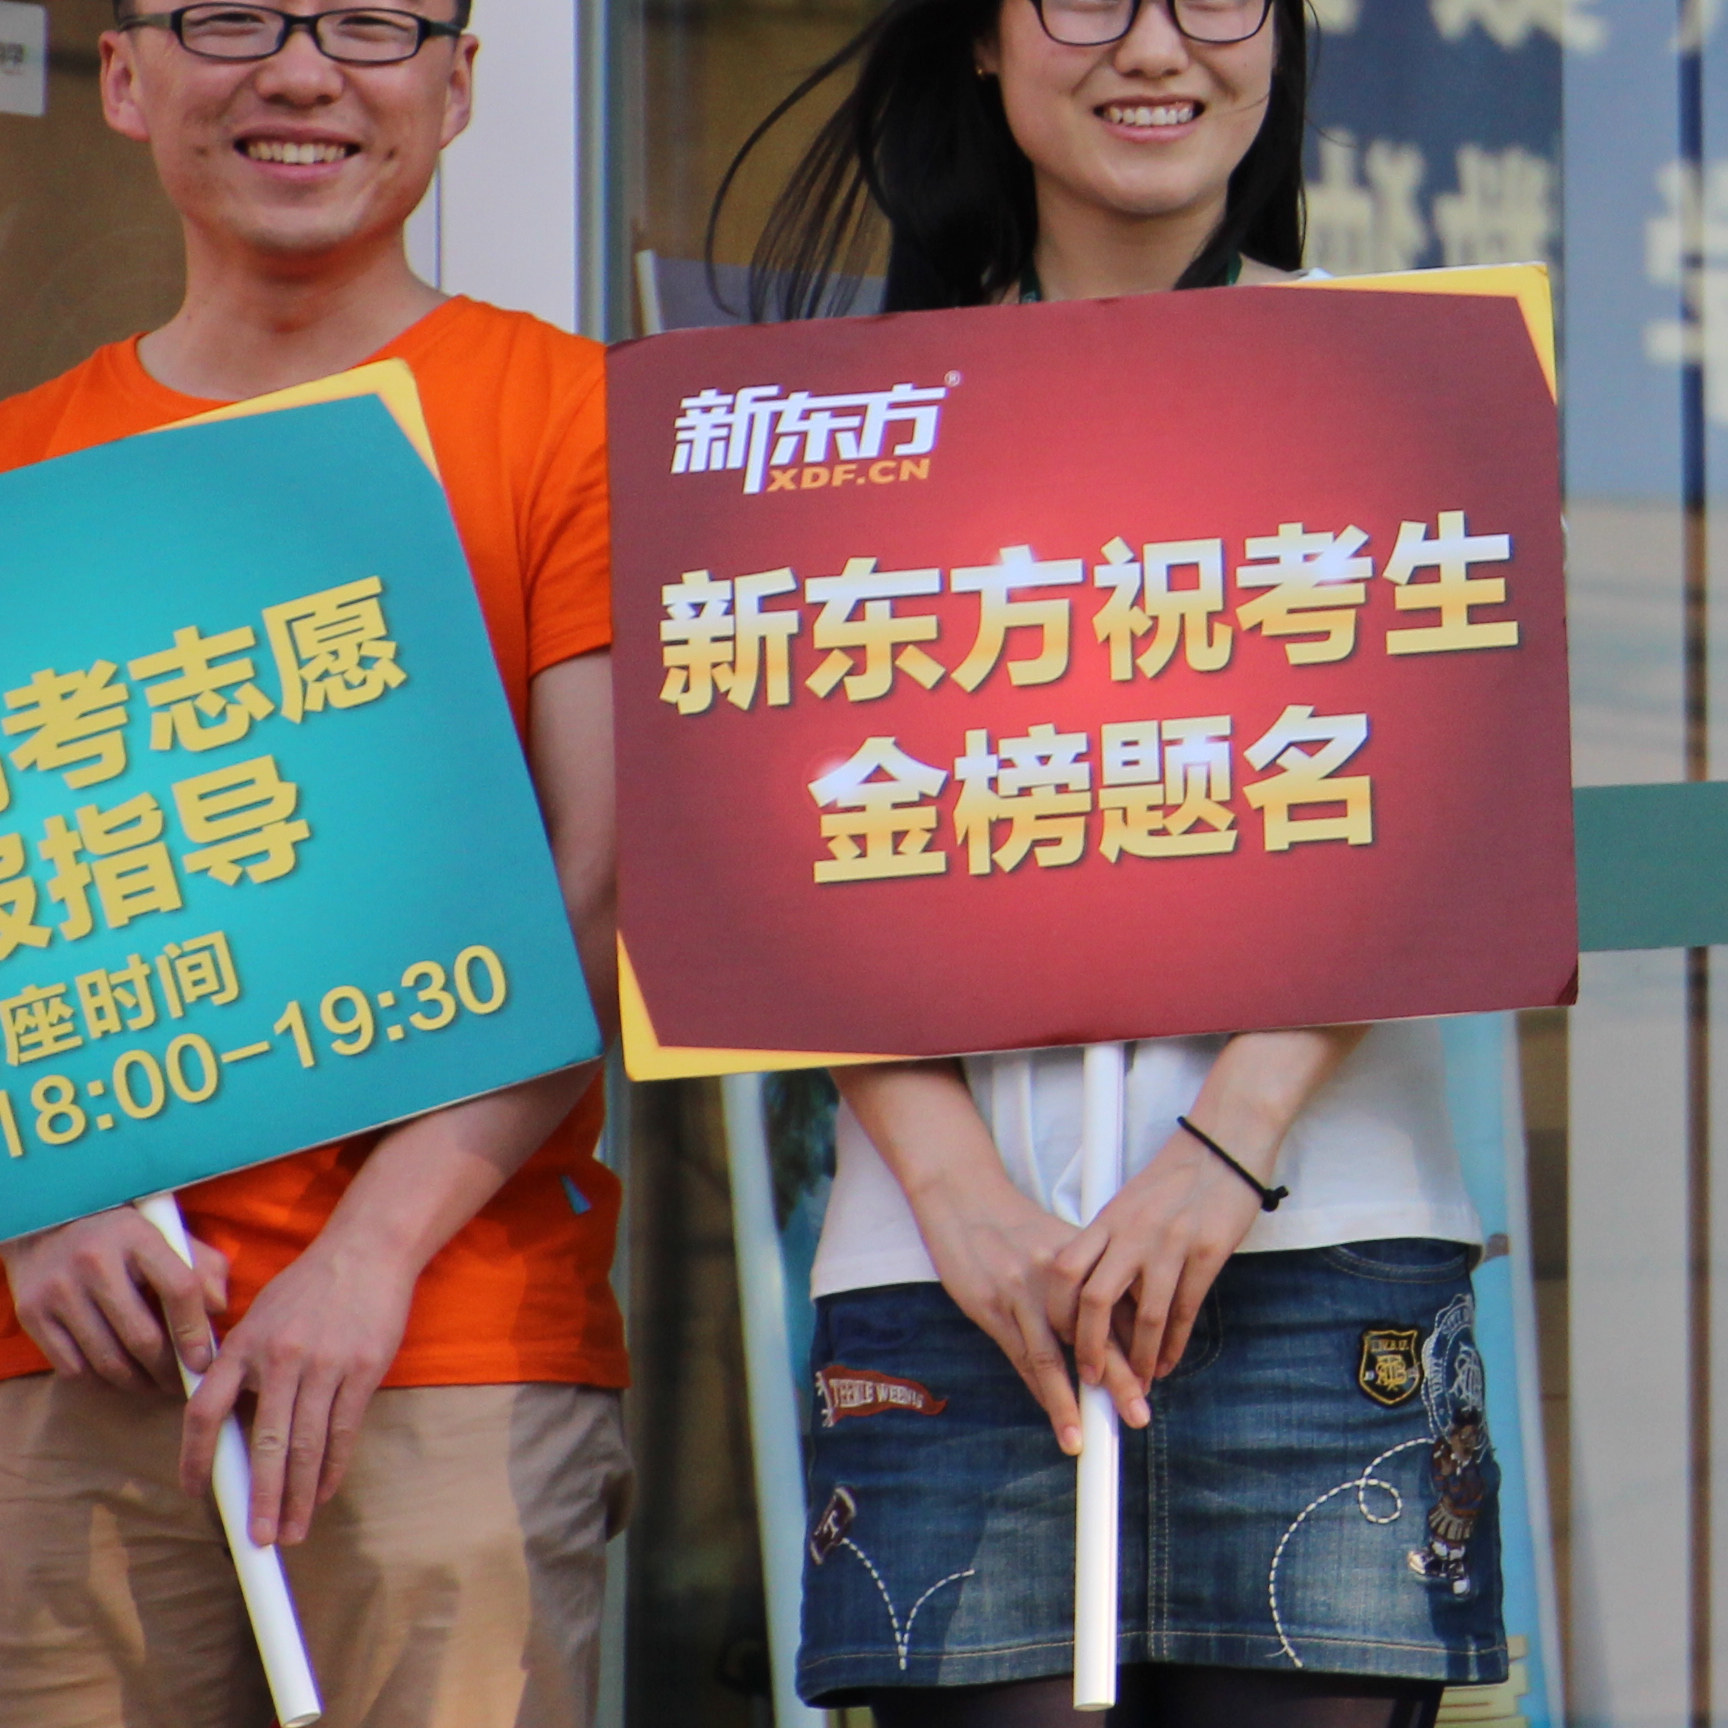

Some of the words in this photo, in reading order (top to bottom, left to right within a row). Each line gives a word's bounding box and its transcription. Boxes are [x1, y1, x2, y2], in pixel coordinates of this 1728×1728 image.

[670, 382, 946, 494] 新东方
[766, 457, 930, 494] XDF.CN
[659, 509, 1520, 718] 新东方祝考生
[0, 576, 407, 812] 考志愿
[807, 704, 1374, 884] 金榜题名
[2, 930, 241, 1068] 座时间
